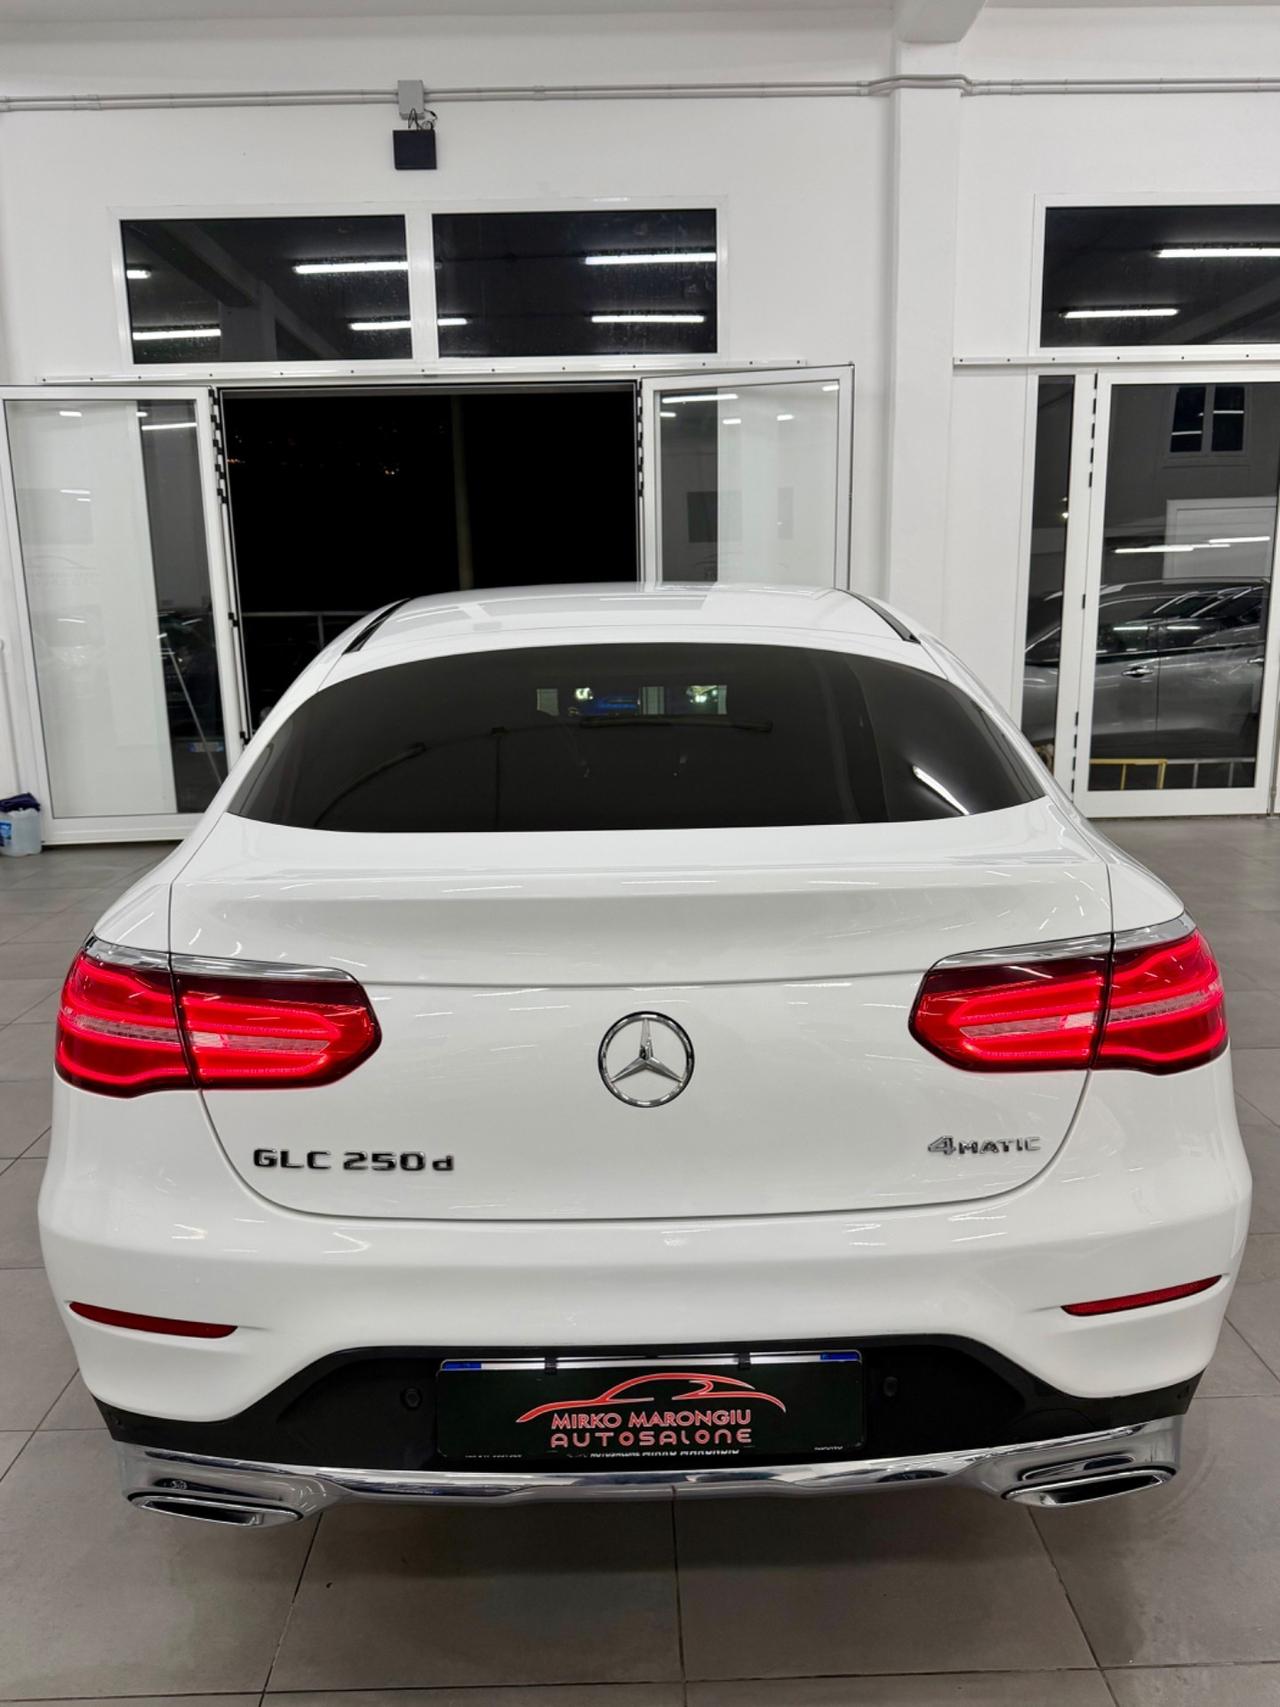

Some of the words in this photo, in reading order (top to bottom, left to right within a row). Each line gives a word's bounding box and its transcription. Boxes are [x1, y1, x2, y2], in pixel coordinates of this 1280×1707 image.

[928, 1135, 1041, 1156] 4MATIC
[253, 1148, 331, 1171] GLC
[551, 1412, 622, 1430] MIRKO
[628, 1409, 751, 1429] MARONGIU
[551, 1428, 752, 1448] AUTOSALONE
